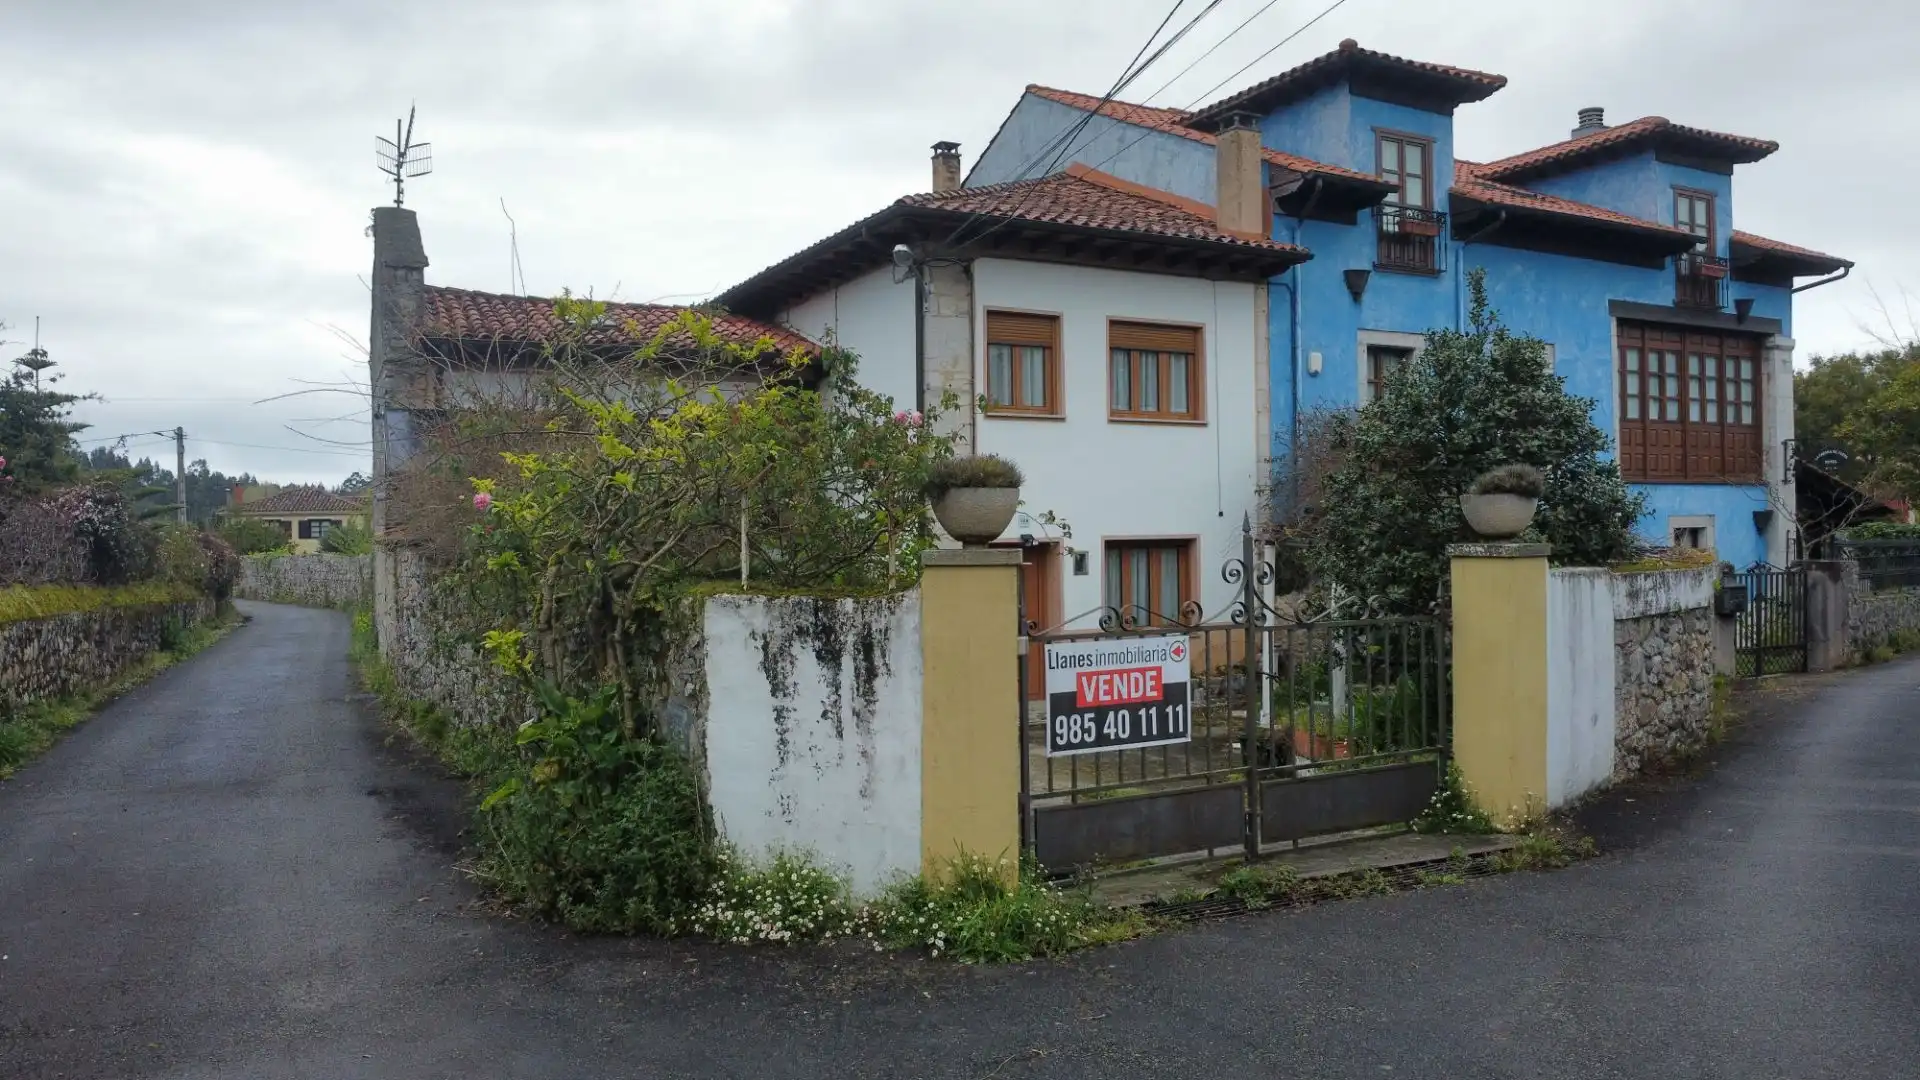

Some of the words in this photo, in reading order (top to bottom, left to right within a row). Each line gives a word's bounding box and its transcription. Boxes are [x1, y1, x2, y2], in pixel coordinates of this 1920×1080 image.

[1048, 651, 1093, 669] Llanes
[1095, 645, 1167, 667] inmobiliaria
[1081, 670, 1158, 703] VENDE
[1055, 712, 1096, 745] 985
[1103, 709, 1130, 740] 40
[1138, 706, 1157, 736] 11
[1165, 704, 1184, 733] 11
